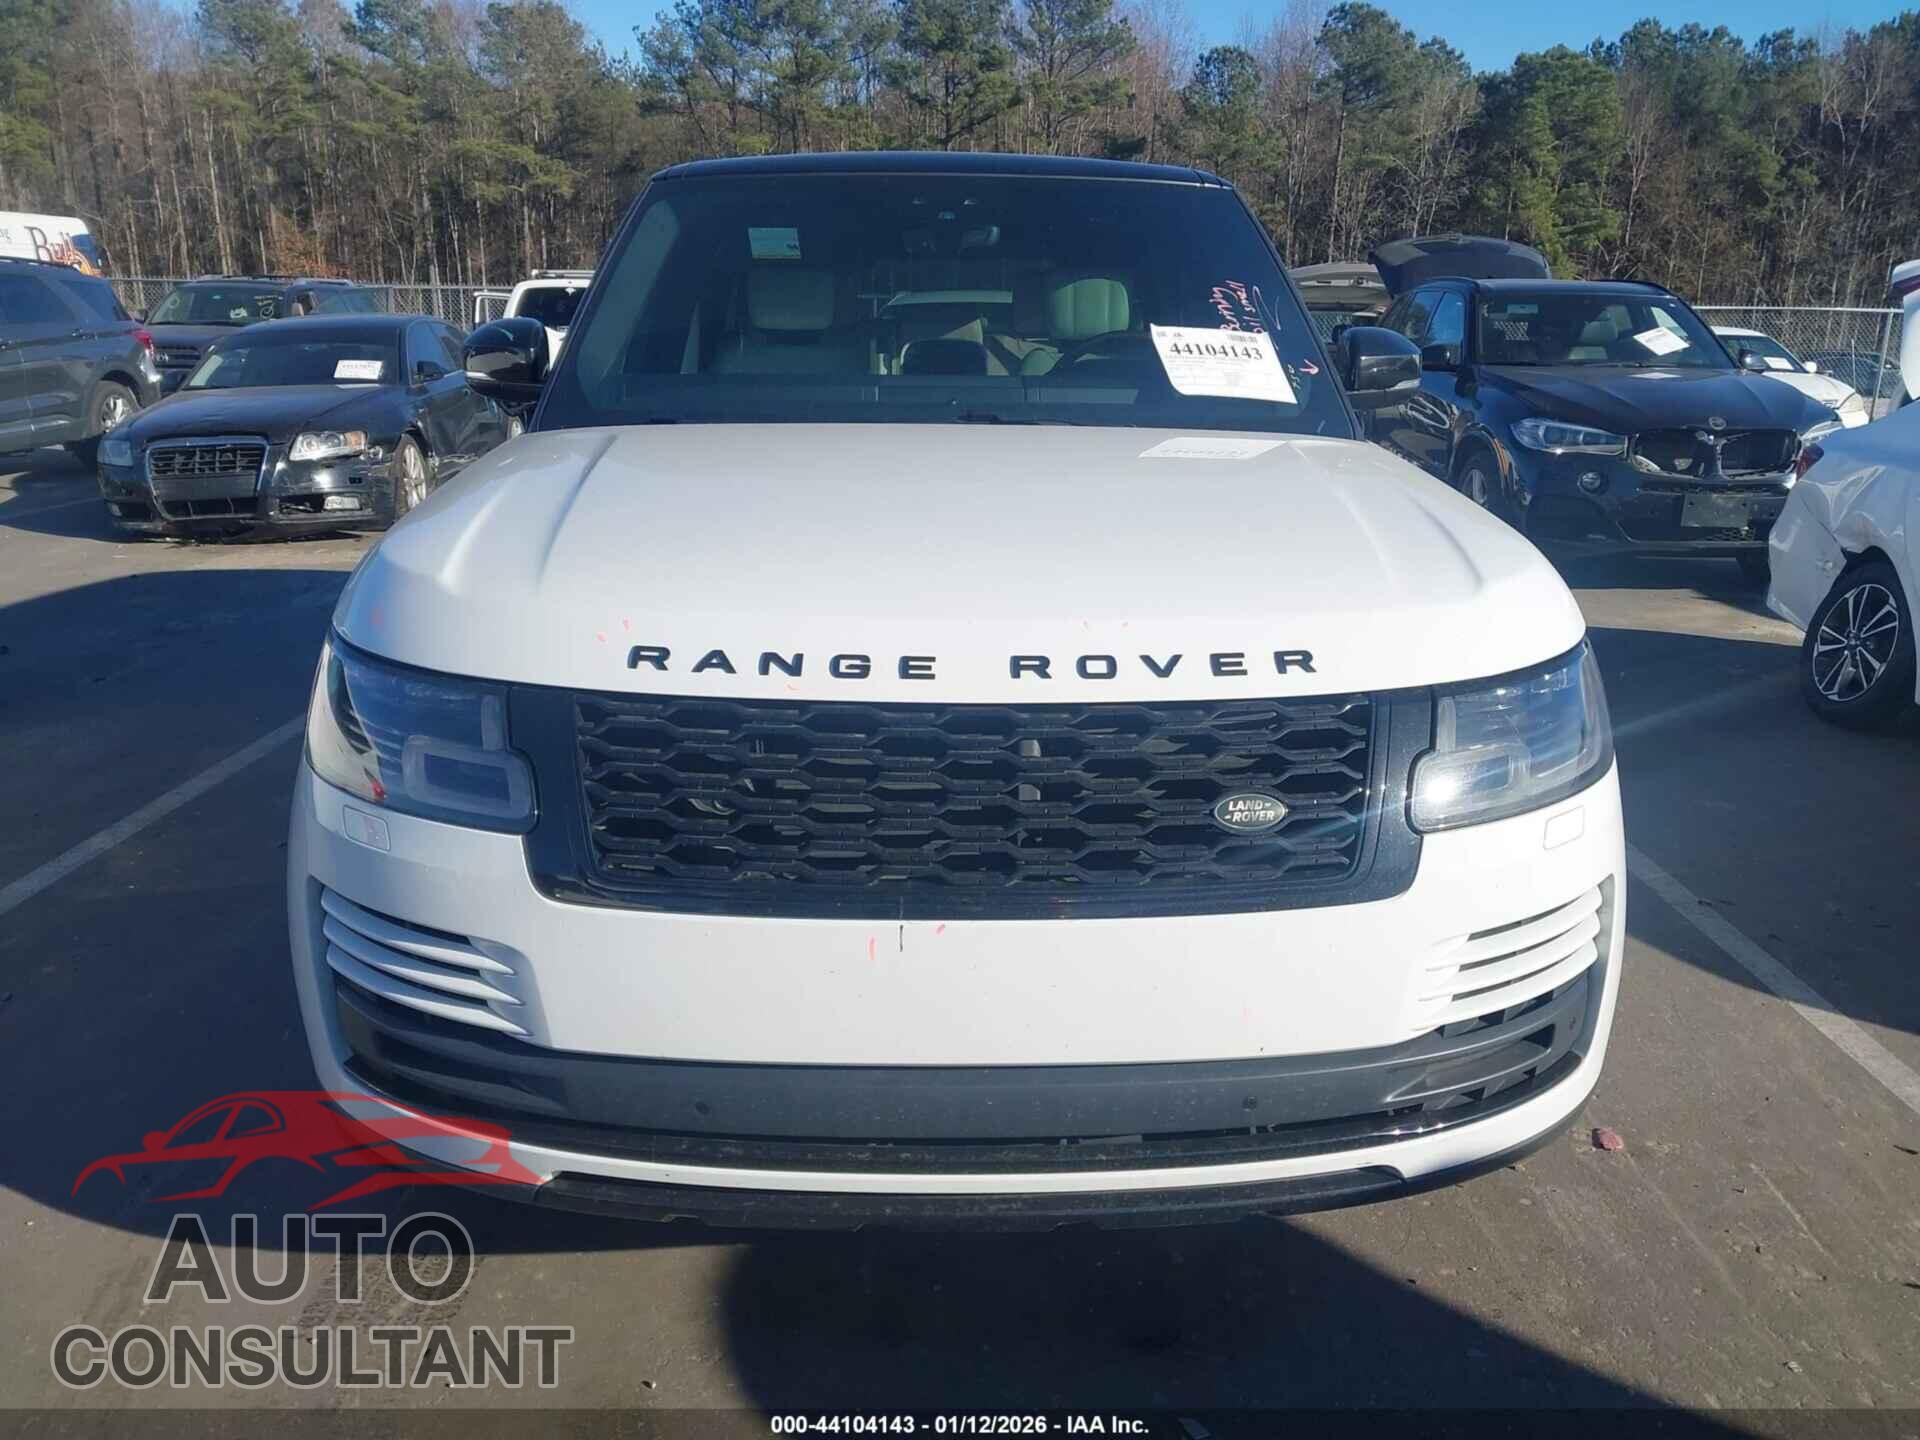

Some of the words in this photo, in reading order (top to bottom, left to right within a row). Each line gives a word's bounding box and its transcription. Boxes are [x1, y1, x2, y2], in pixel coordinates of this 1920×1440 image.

[1169, 341, 1264, 361] 44104143
[627, 644, 937, 681] RANGE
[1009, 649, 1318, 680] ROVER
[1228, 799, 1264, 811] LAND
[1232, 810, 1275, 822] ROVER
